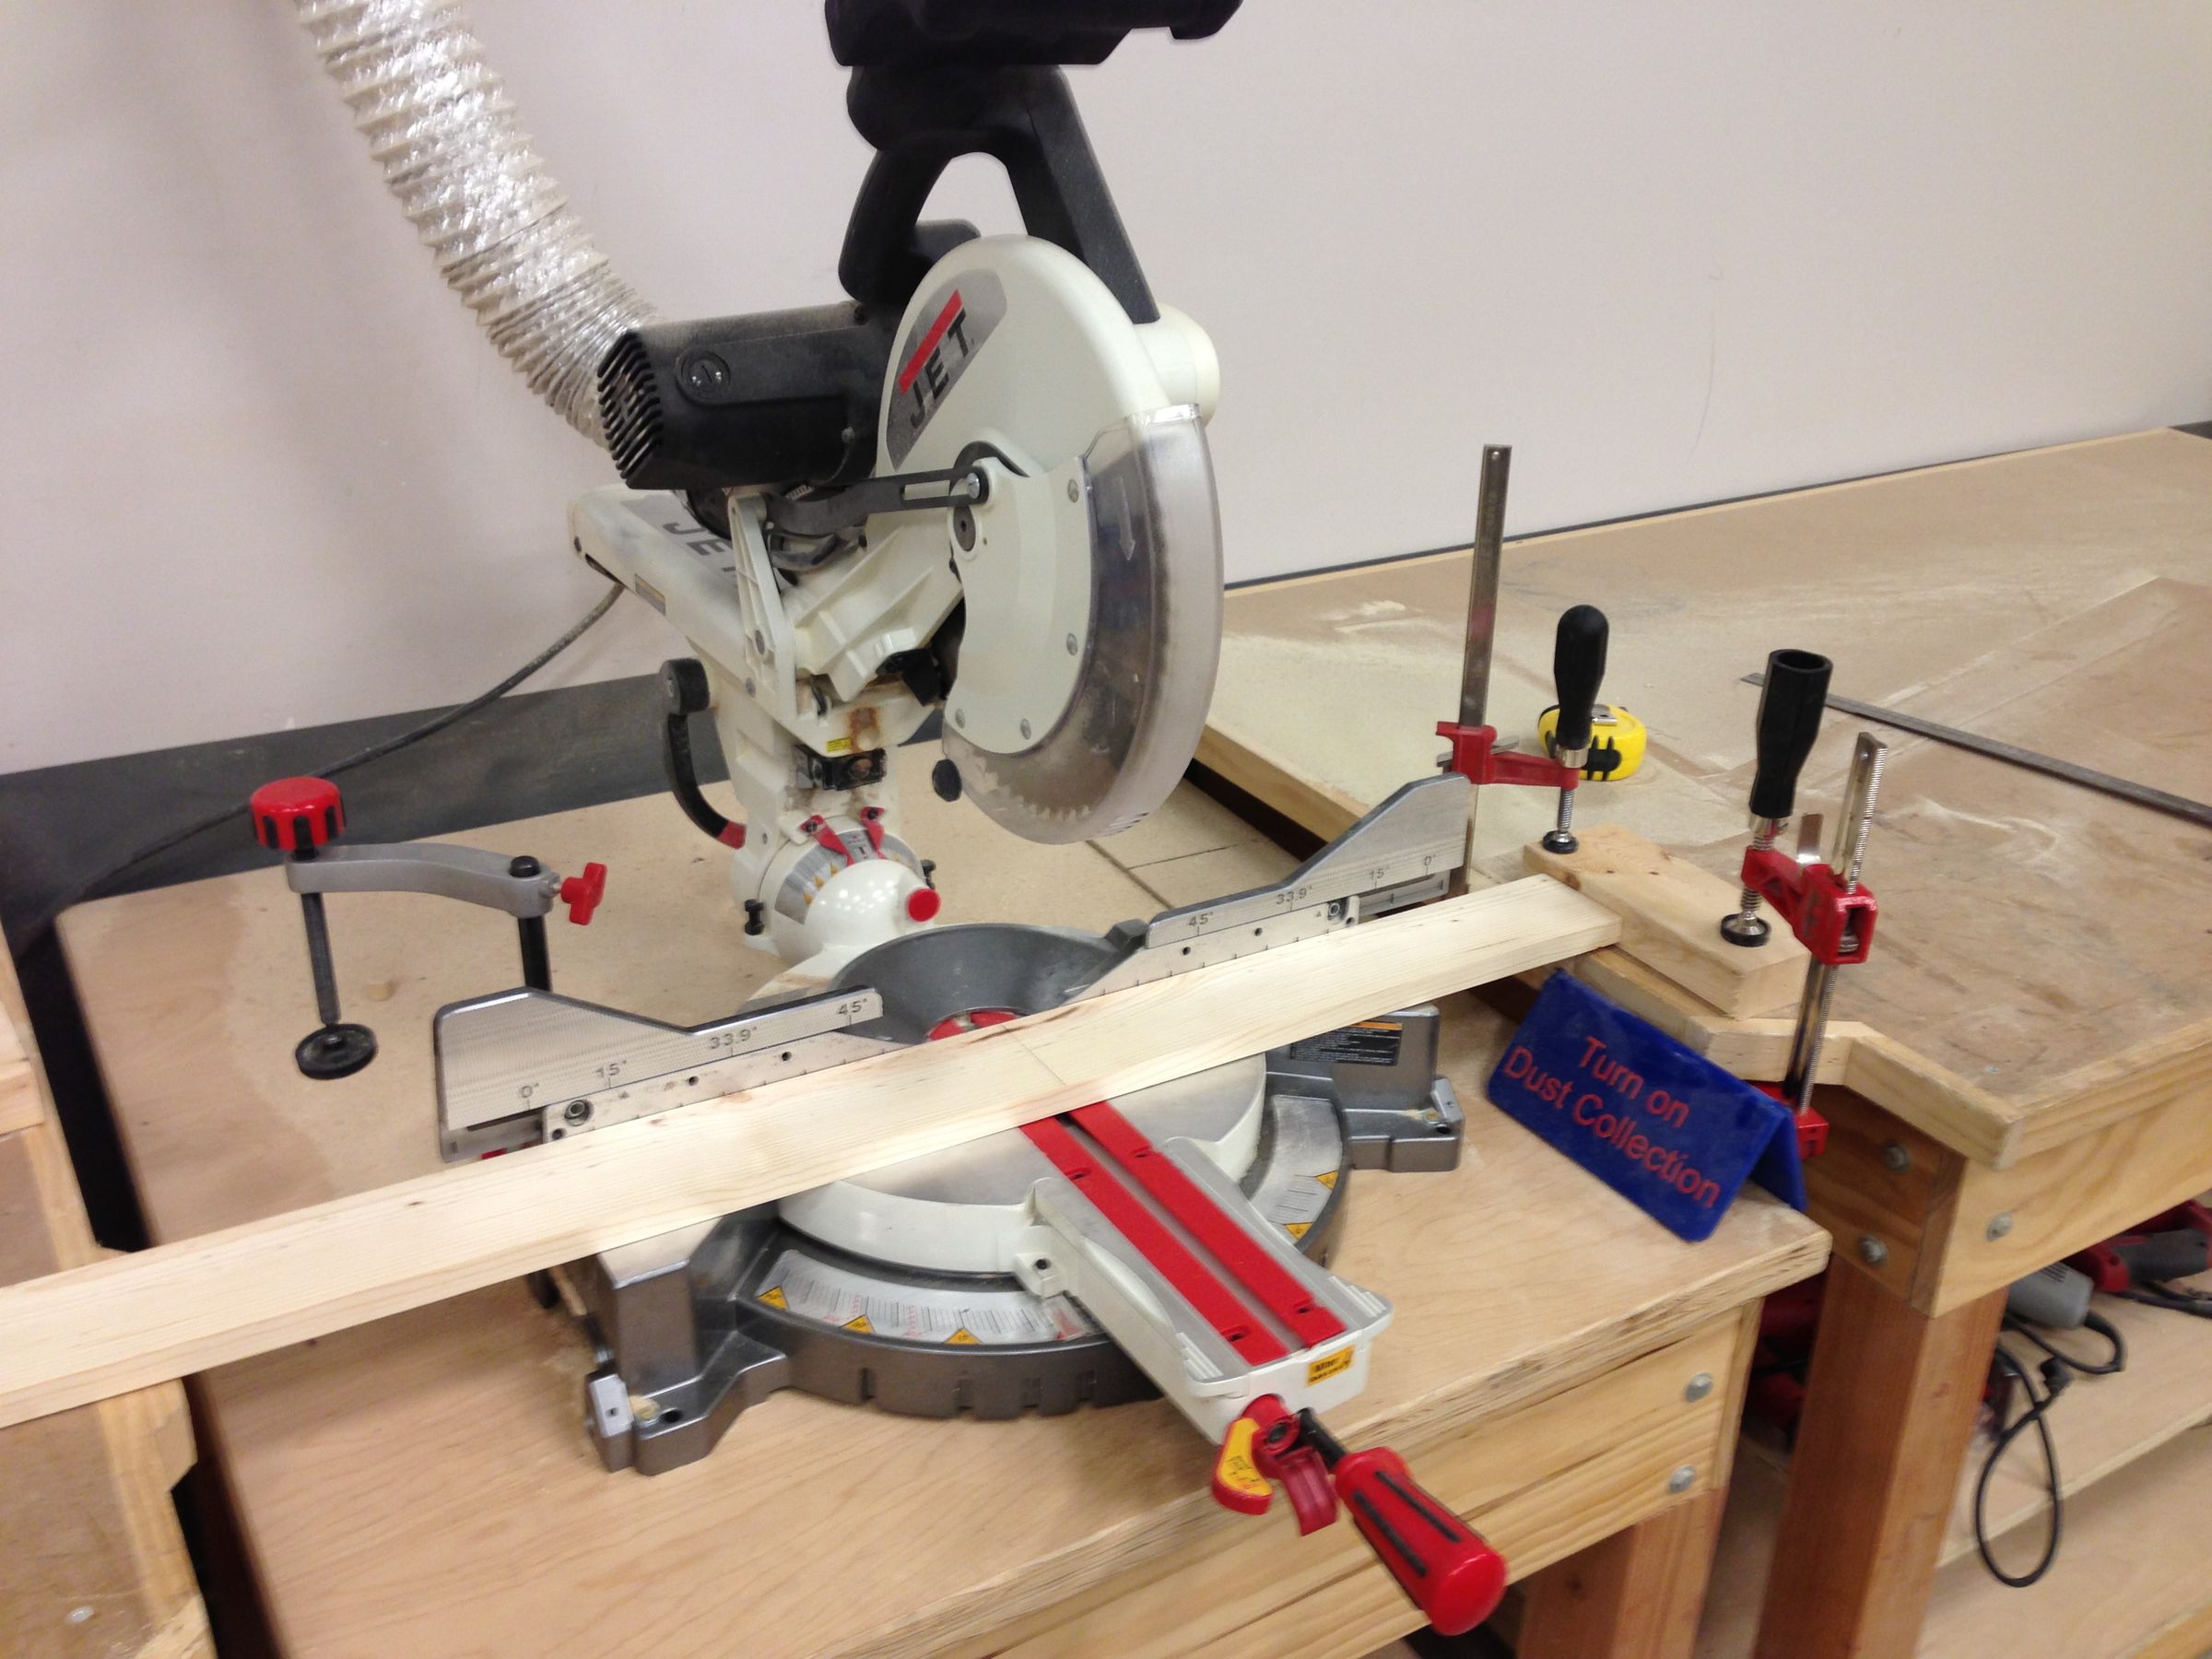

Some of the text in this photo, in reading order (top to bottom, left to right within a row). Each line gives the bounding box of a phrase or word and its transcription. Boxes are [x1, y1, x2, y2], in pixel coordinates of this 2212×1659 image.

[910, 308, 969, 429] JET
[1188, 911, 1214, 926] 45°
[838, 998, 867, 1017] 45°
[595, 1060, 627, 1078] 15°
[1577, 1035, 1690, 1128] Turn on
[1503, 1046, 1574, 1109] Dust
[1571, 1093, 1722, 1208] Collection
